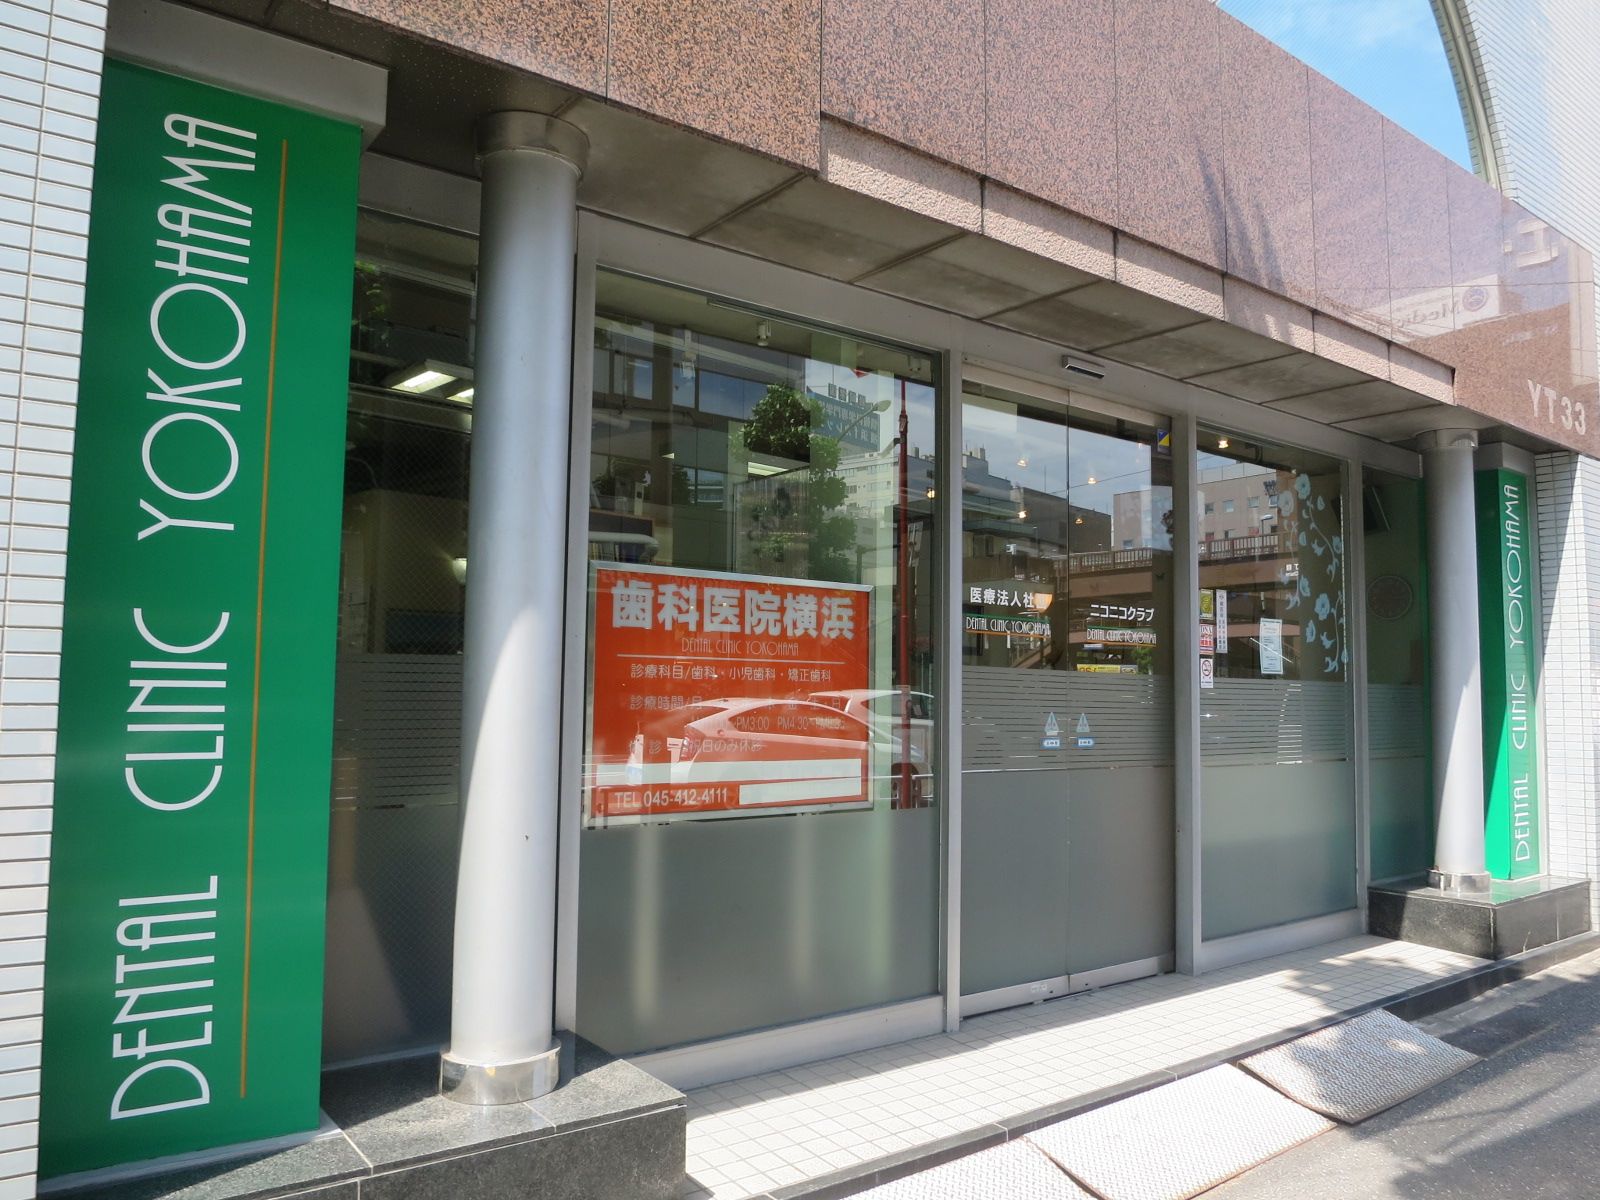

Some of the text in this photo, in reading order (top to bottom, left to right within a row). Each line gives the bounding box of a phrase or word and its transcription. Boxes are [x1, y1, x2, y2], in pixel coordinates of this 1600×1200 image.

[110, 113, 257, 1120] DENTAL CLINIC YOKOHAMA
[611, 579, 855, 640] 歯科医院横浜
[1090, 604, 1155, 621] ニコニコクラブ
[966, 617, 1051, 637] DENTAL CLINIC YOKOHAMA
[1087, 629, 1105, 640] DENTAL
[682, 638, 799, 656] DENTAL CLINIC YOKOHAMA
[1504, 484, 1530, 862] DENTAL CLINIC YOKOHAMA
[614, 787, 728, 808] TEL 045-412-4111
